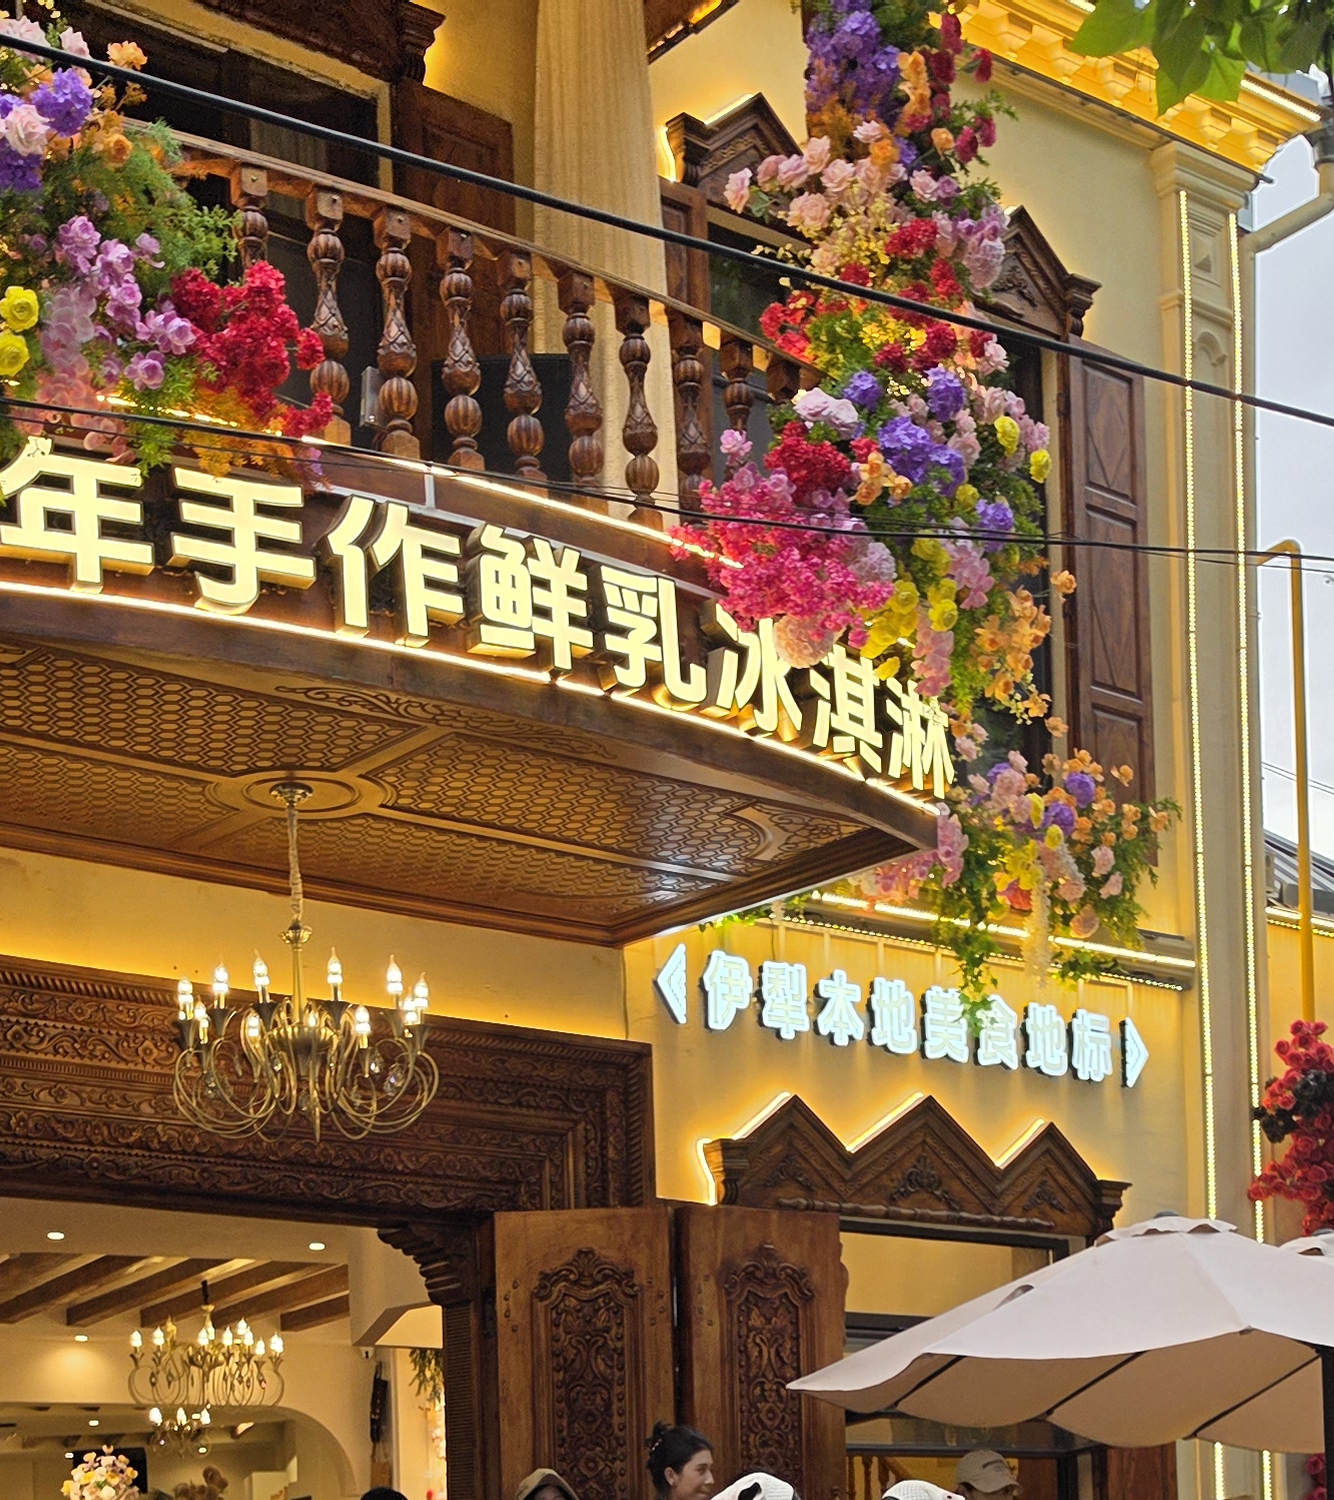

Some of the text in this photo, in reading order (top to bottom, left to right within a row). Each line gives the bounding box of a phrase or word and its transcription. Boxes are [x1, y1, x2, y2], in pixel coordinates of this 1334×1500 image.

[703, 949, 1113, 1082] 伊犁本地美食地标
